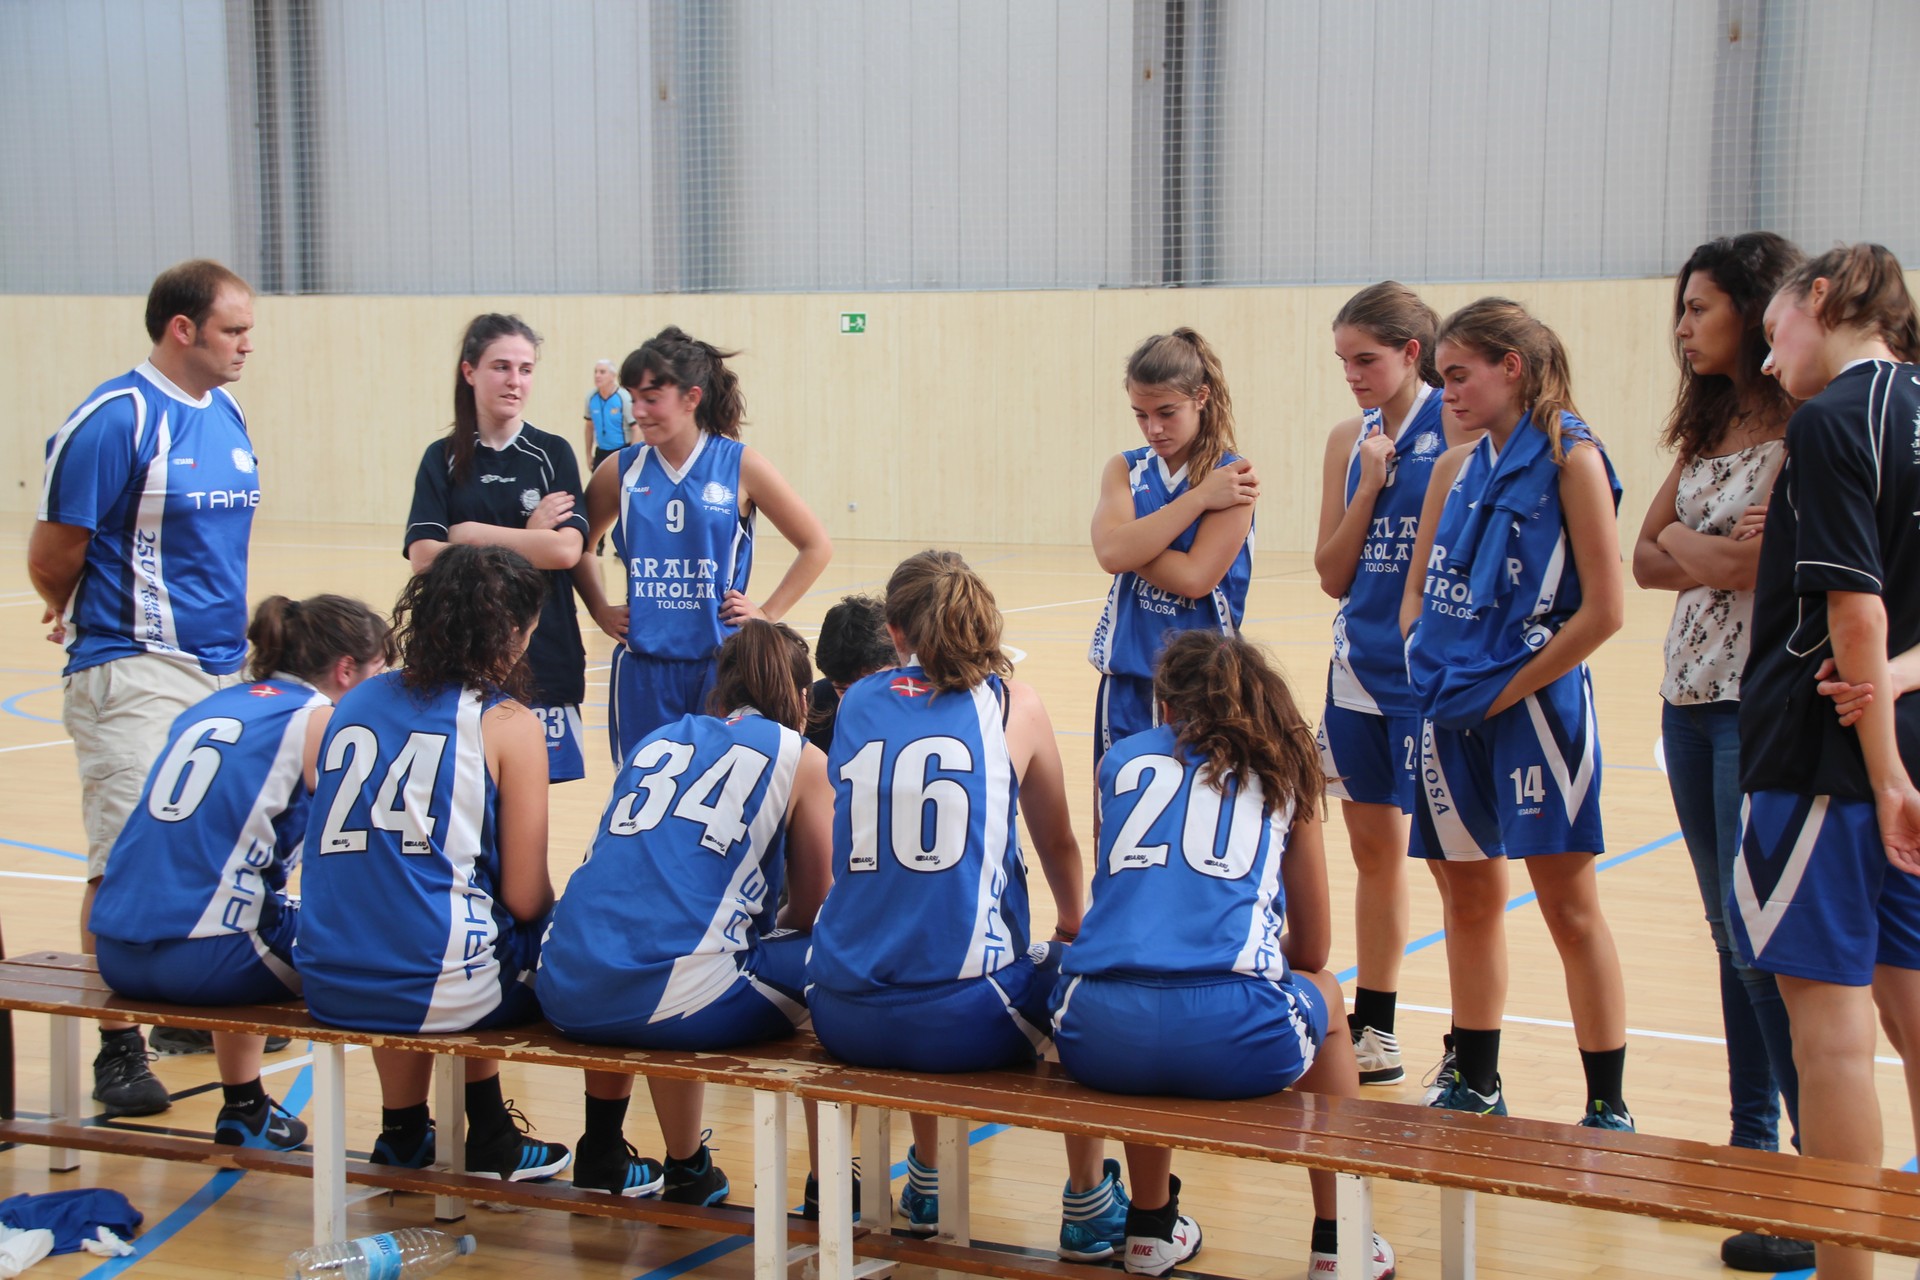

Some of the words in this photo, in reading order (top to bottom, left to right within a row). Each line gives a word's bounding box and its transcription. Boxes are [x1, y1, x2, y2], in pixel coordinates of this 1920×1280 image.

[666, 499, 685, 533] 9
[1365, 562, 1400, 573] TOLOSA
[656, 600, 701, 610] TOLOSA
[1139, 598, 1177, 617] TOLOSA
[148, 716, 245, 824] 6
[1403, 735, 1418, 771] 2
[319, 724, 449, 856] 24
[608, 738, 771, 858] 34
[1509, 765, 1546, 805] 14
[839, 735, 974, 874] 16
[1108, 753, 1266, 881] 20
[1131, 1243, 1154, 1257] NIKE
[1314, 1259, 1337, 1272] NIKE
